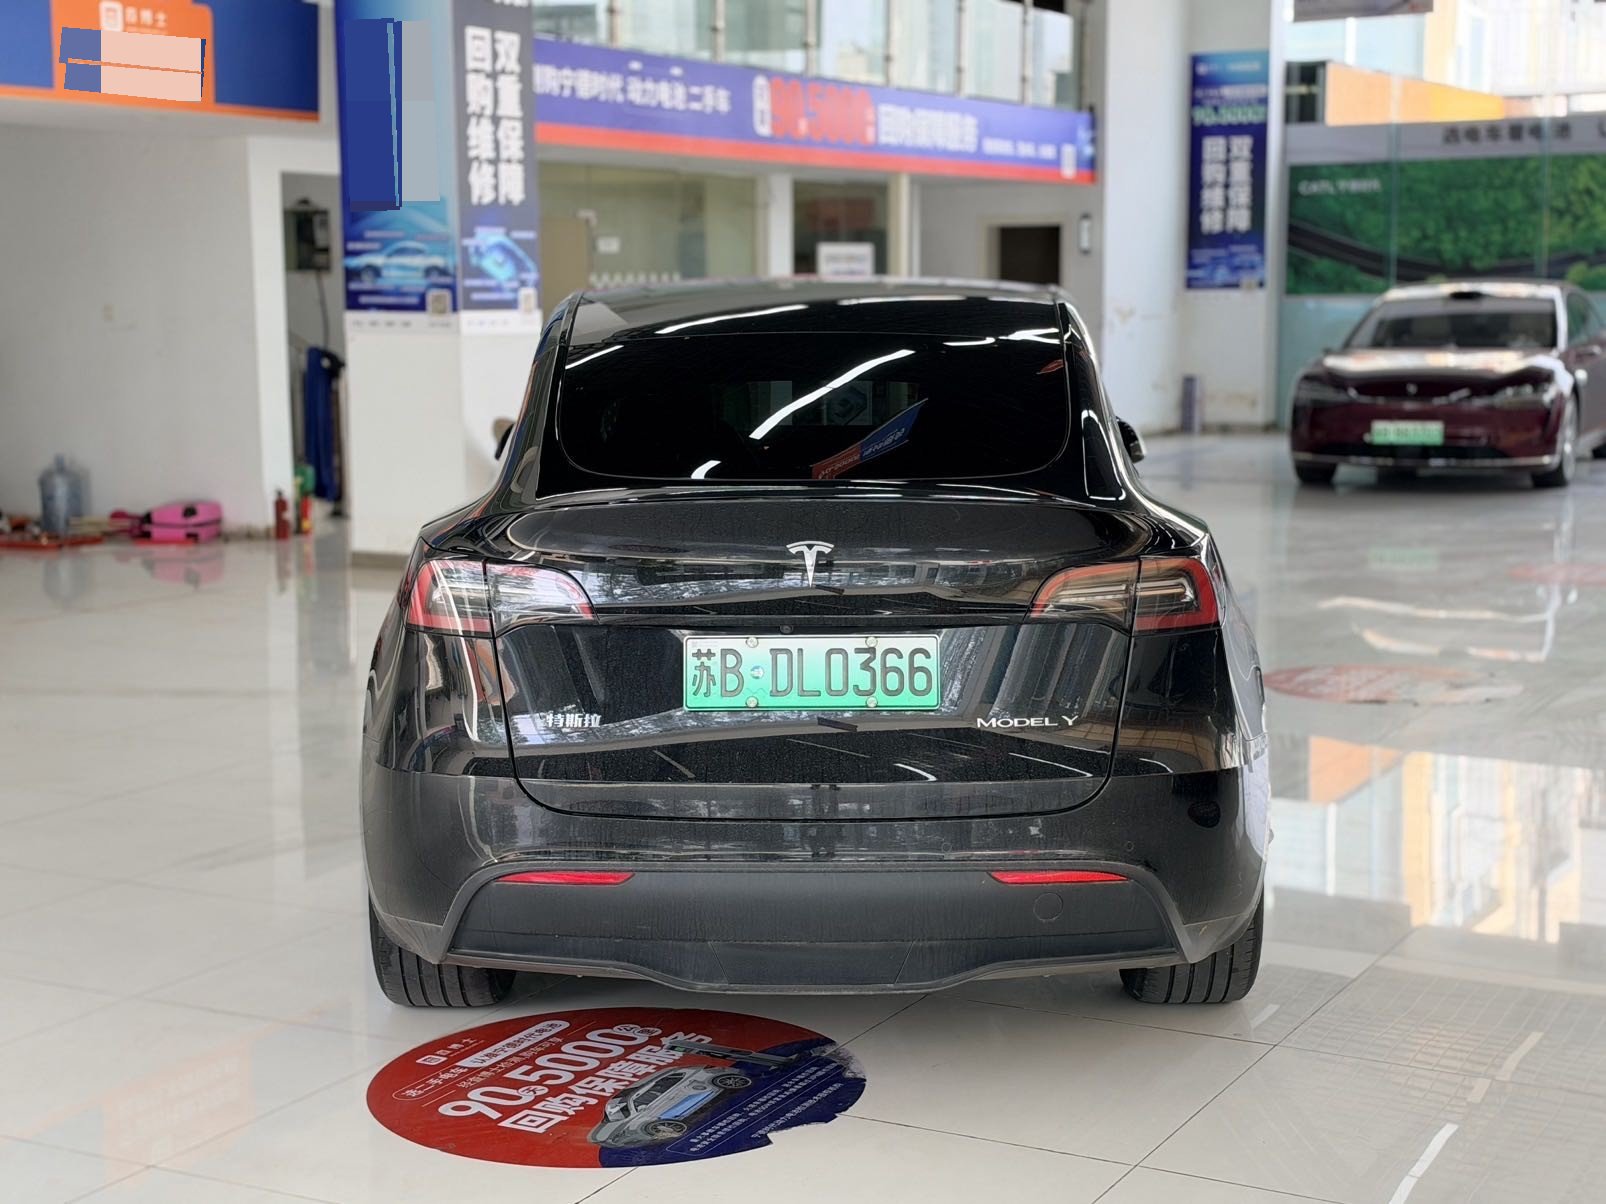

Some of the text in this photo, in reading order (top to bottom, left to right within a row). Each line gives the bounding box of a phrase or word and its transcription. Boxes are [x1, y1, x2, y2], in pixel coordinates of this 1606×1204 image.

[464, 25, 497, 206] 回购维修
[494, 31, 526, 206] 双重保障
[768, 647, 934, 698] DL0366
[546, 713, 602, 728] 特斯拉
[976, 715, 1079, 728] MODEL Y
[498, 1031, 713, 1134] 回购保障服务
